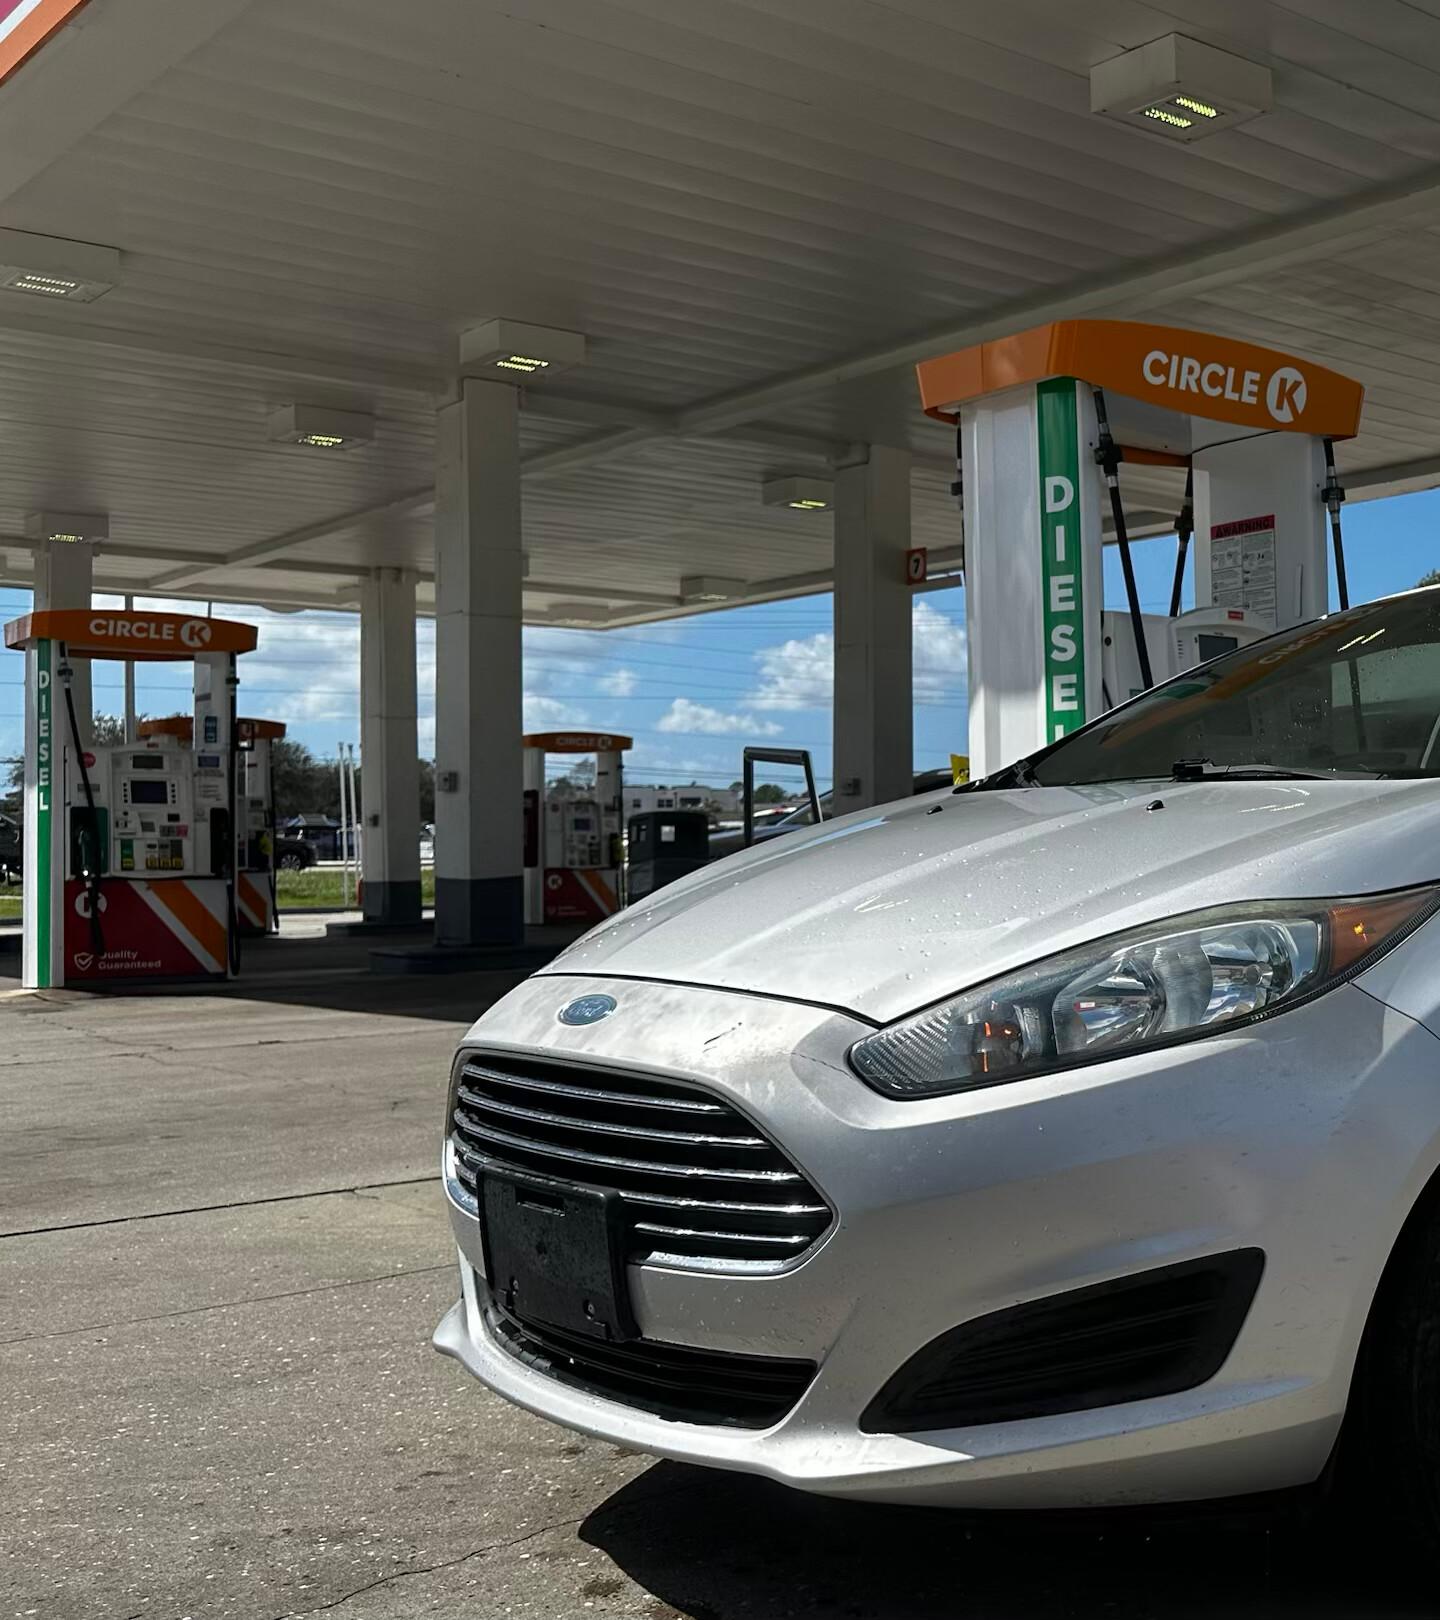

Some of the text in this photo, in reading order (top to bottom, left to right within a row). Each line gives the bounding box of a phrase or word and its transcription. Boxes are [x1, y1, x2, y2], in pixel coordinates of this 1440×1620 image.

[1143, 351, 1307, 423] CIRCLE K
[1222, 518, 1270, 537] WARNING
[911, 558, 921, 575] 7
[89, 619, 212, 648] CIRCLE K
[38, 670, 50, 811] DIESEL
[98, 960, 161, 970] Guaranteed
